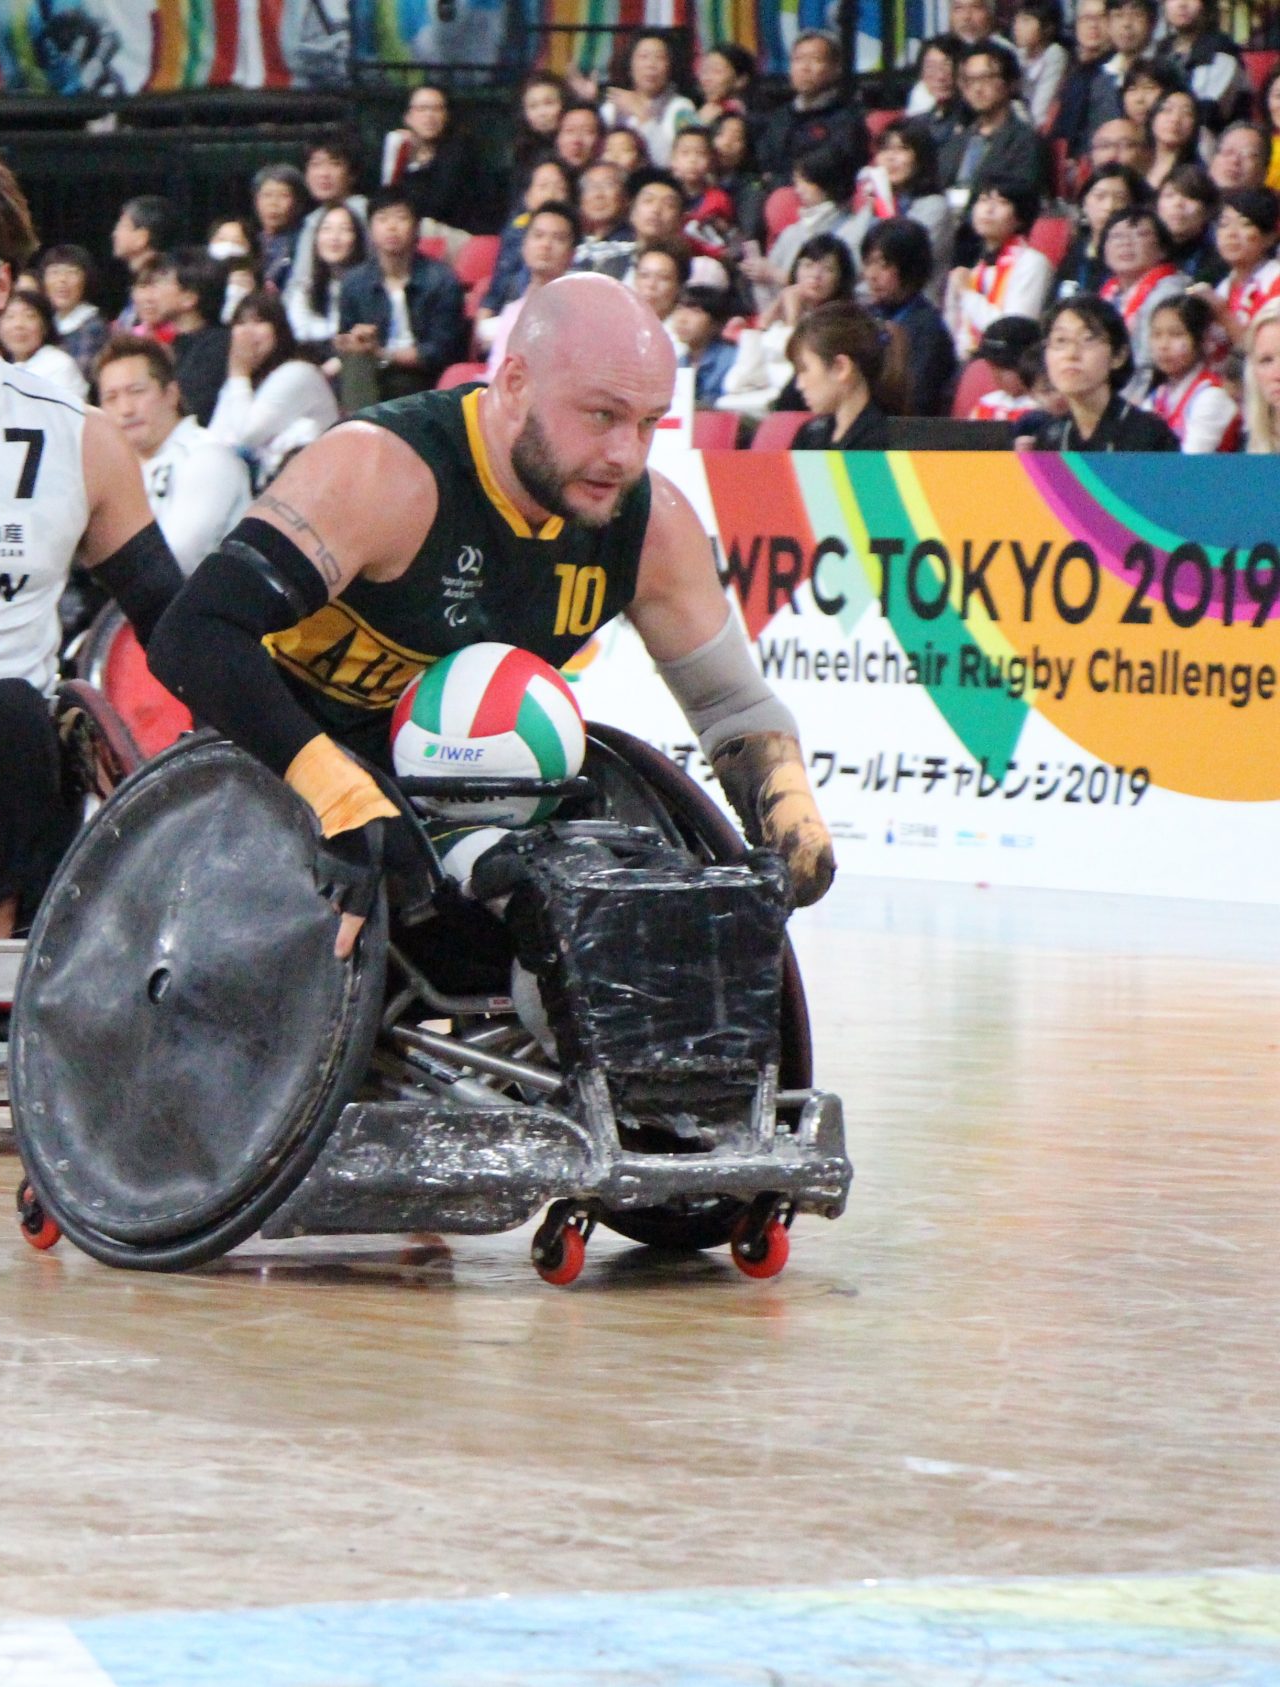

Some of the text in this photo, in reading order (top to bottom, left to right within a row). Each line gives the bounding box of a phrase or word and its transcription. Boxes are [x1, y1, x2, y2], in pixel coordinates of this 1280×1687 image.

[3, 428, 45, 499] 7
[553, 563, 607, 636] 10
[869, 538, 1100, 625] TOKYO
[1118, 541, 1280, 628] 2019
[308, 626, 406, 699] AU
[758, 636, 1276, 708] Wheelchair Rugby Challenge
[440, 746, 485, 761] IWRF
